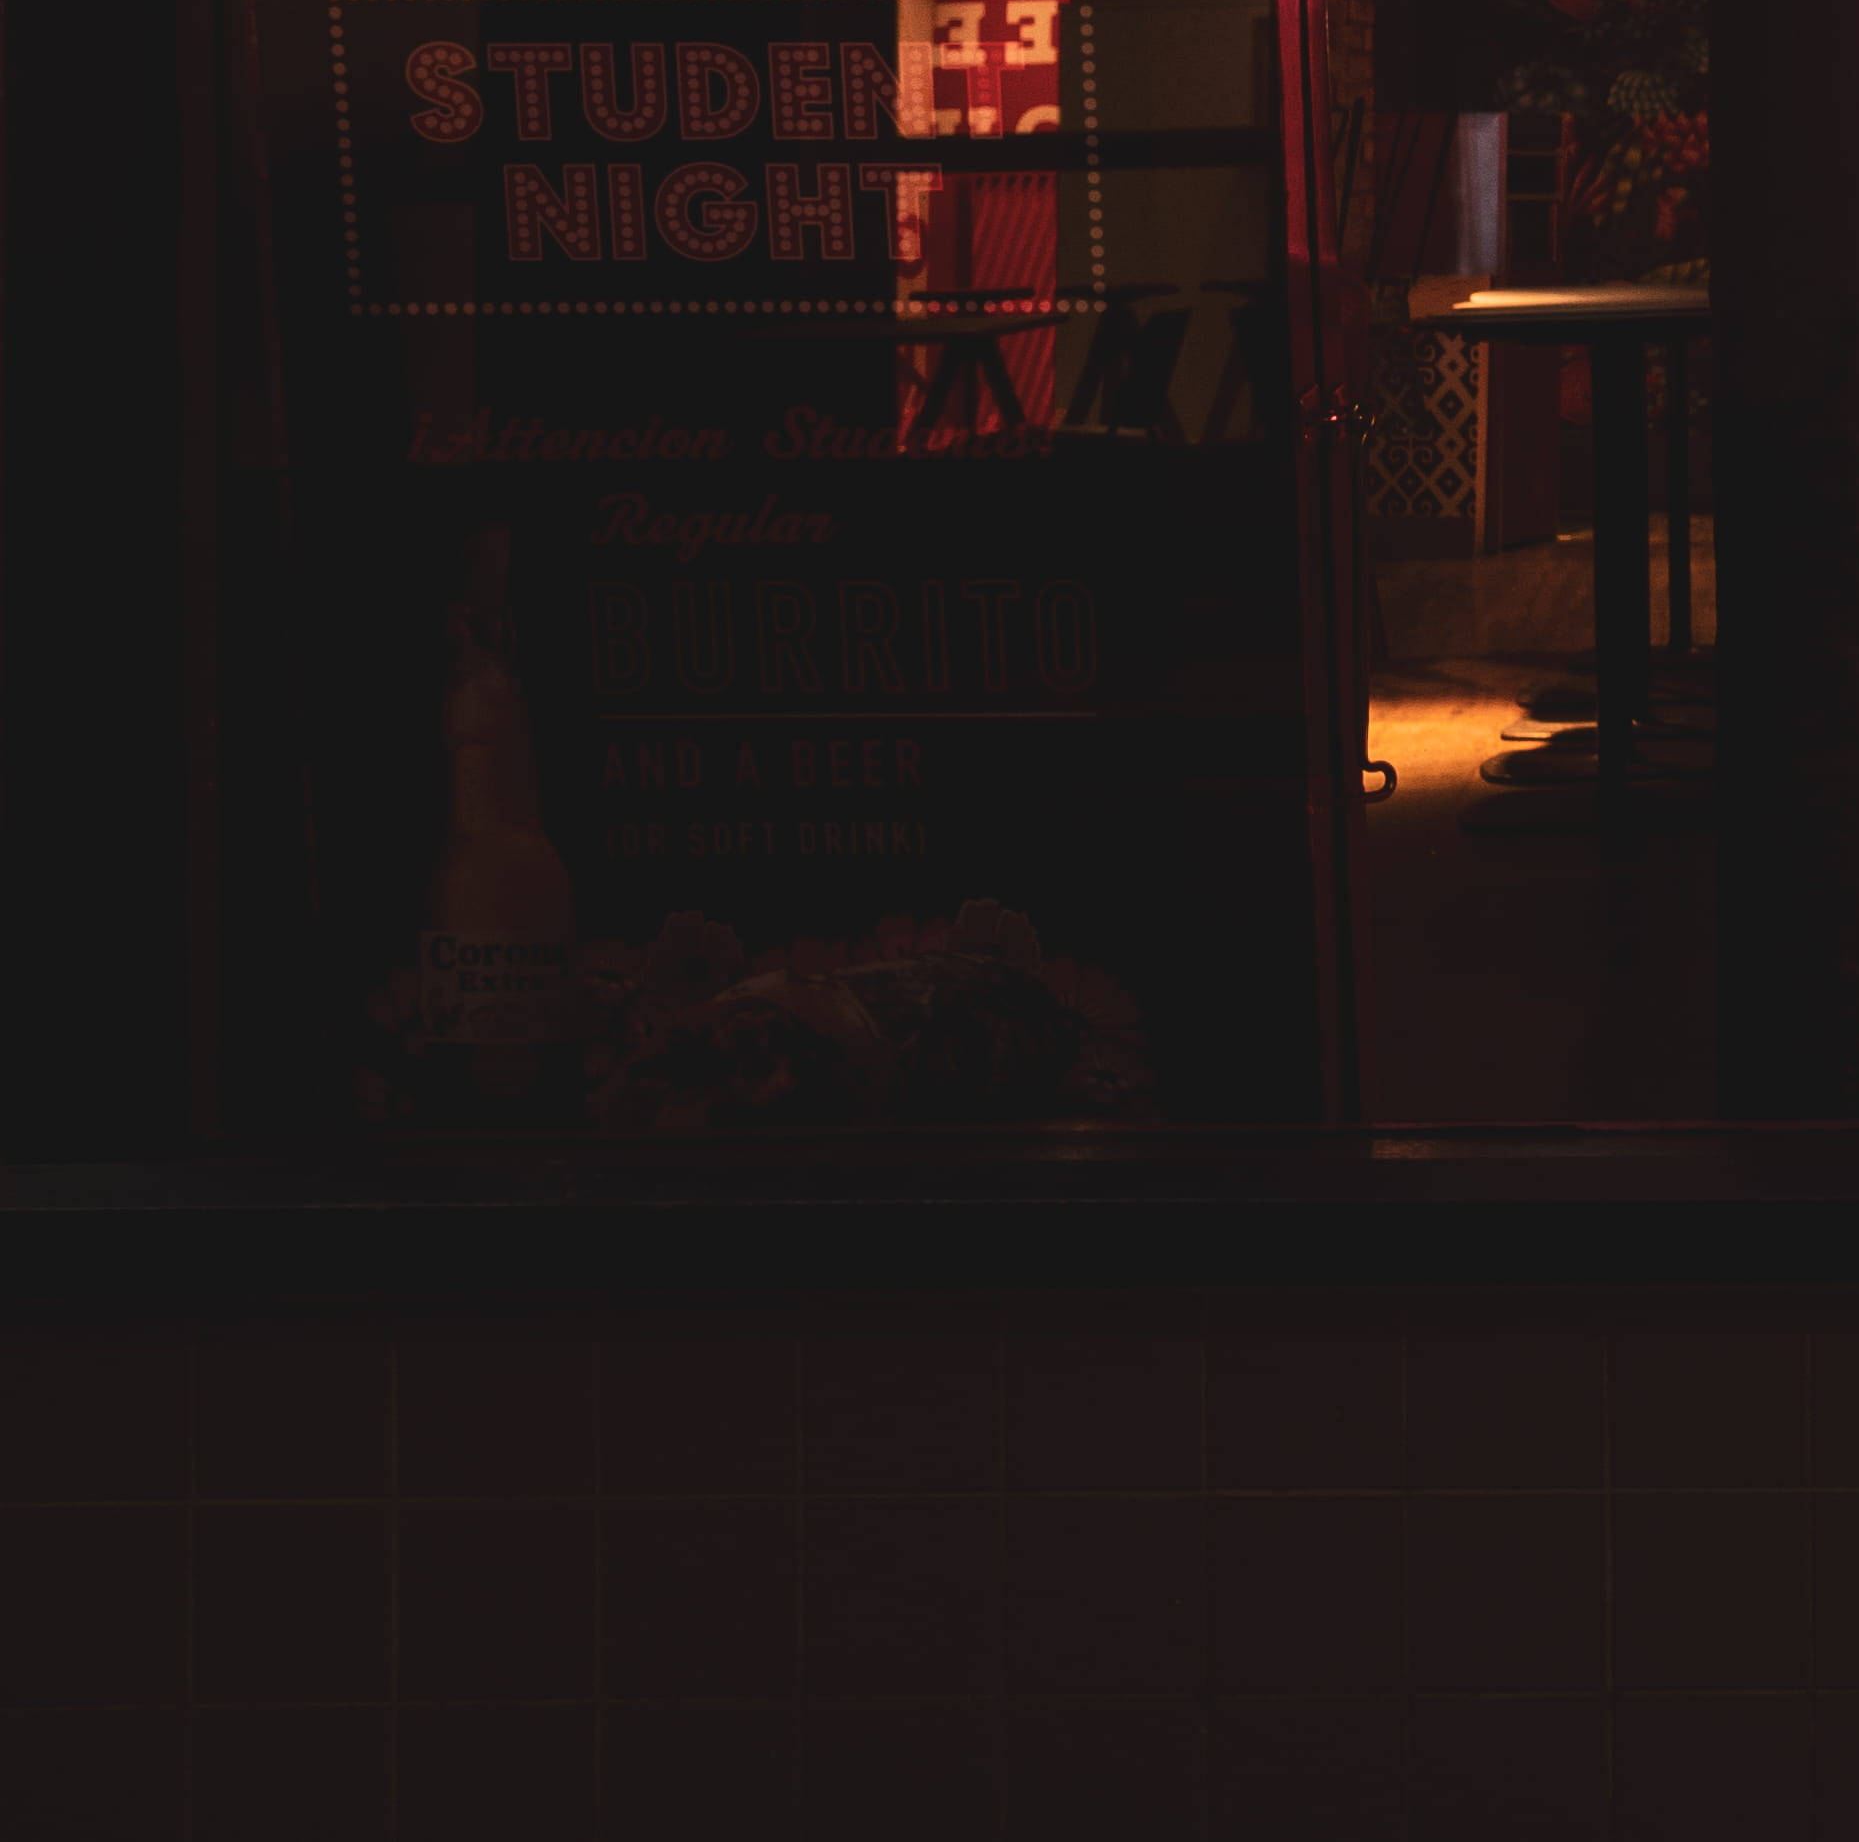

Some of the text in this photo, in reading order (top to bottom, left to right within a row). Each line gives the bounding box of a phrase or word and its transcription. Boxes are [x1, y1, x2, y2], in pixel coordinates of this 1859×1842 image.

[405, 39, 1026, 143] STUDENT
[502, 160, 945, 263] NIGHT
[588, 489, 840, 564] Regular
[584, 575, 1100, 695] BURRITO
[600, 737, 927, 791] AND A BEER
